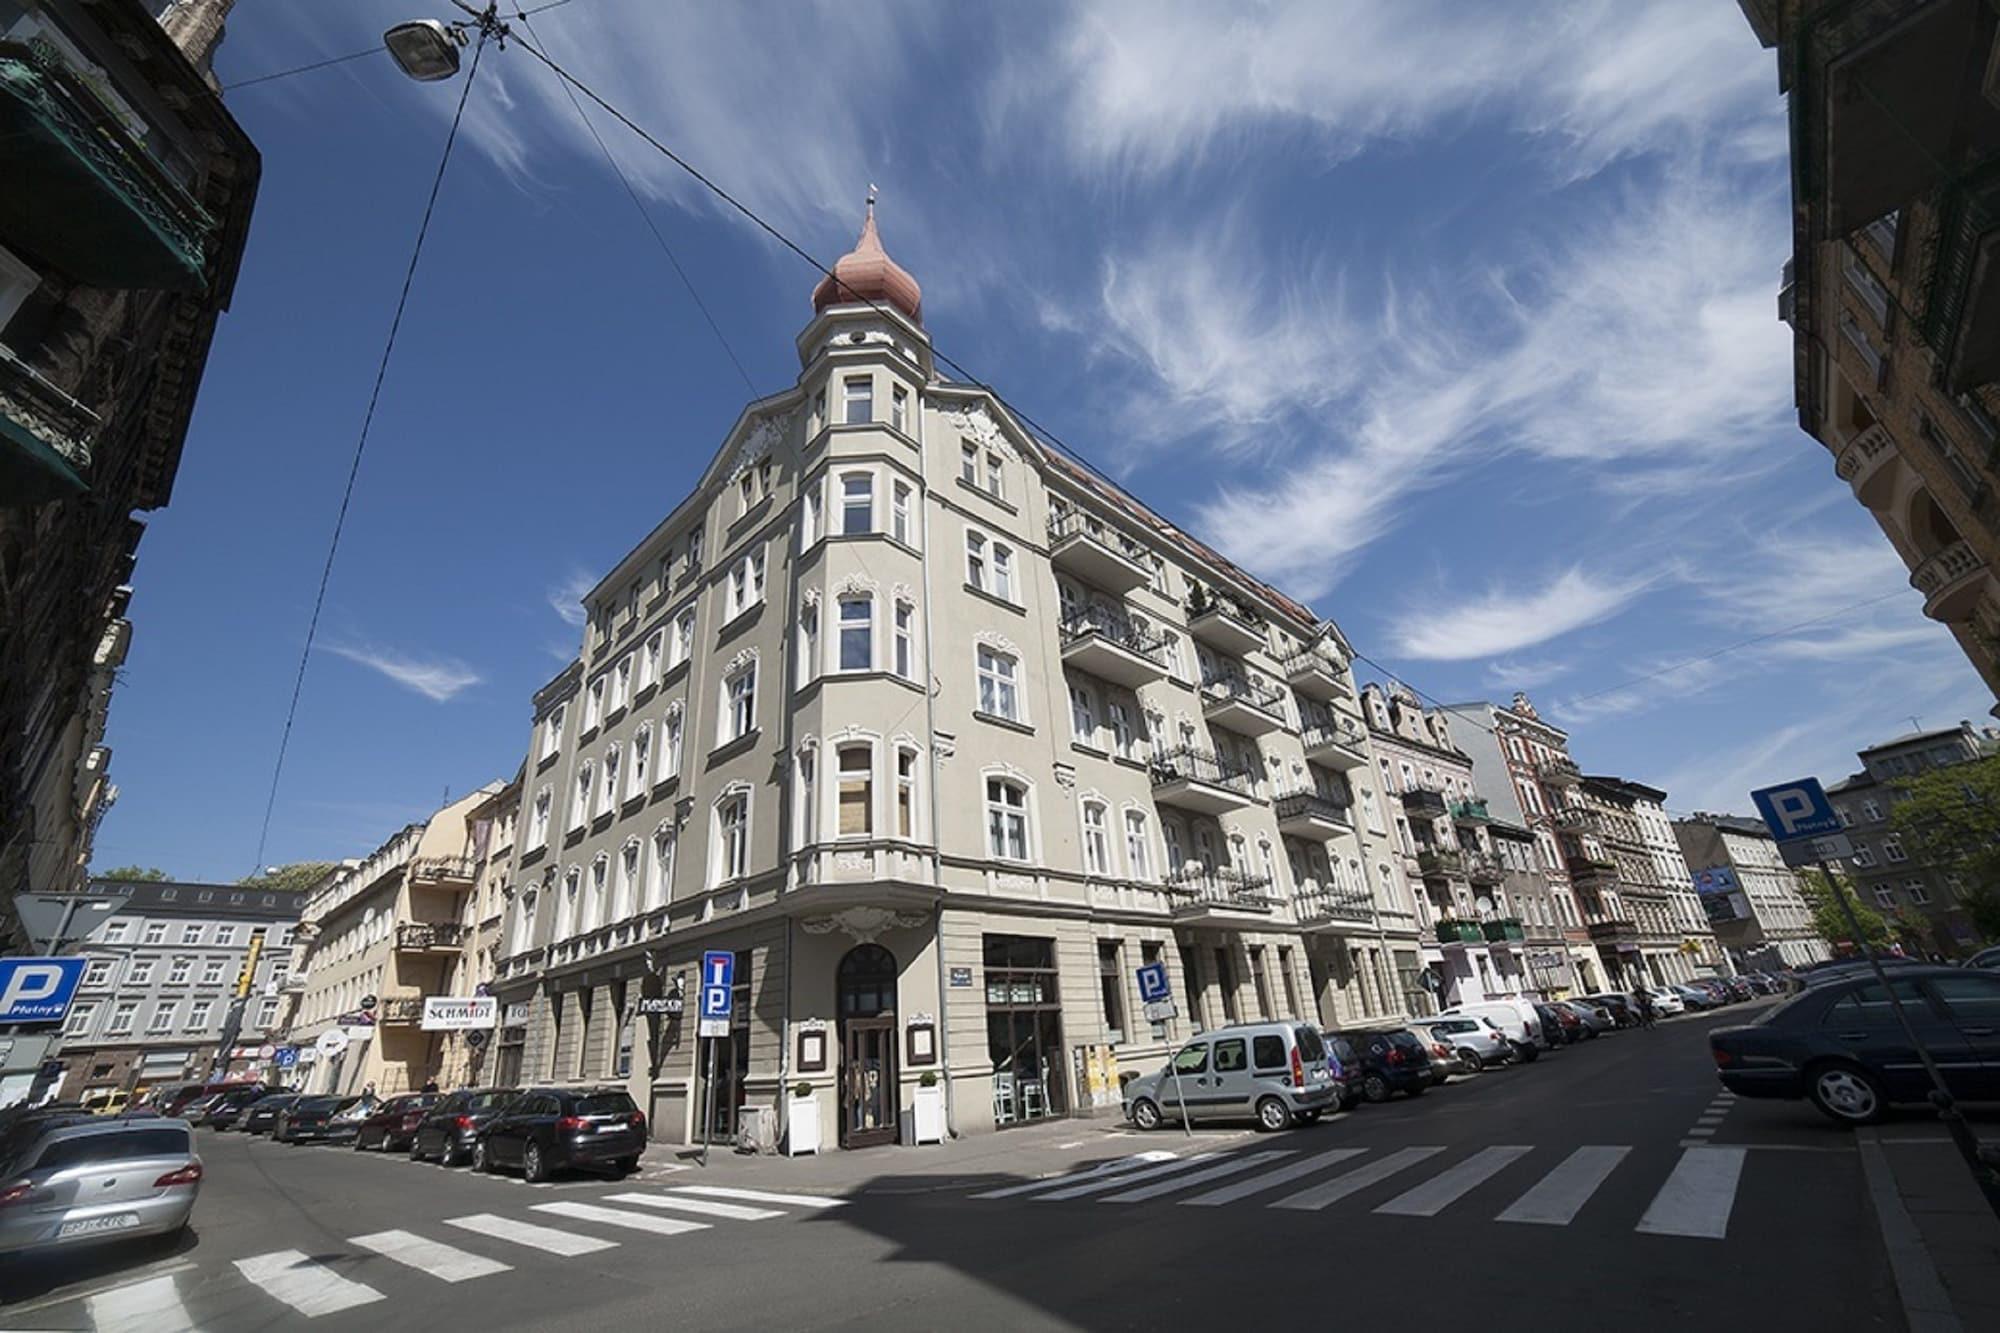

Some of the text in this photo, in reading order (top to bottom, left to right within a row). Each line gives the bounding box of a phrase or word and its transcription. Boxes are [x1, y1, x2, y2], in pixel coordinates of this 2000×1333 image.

[1767, 788, 1816, 833] P
[0, 965, 63, 1014] P
[707, 988, 726, 1014] P
